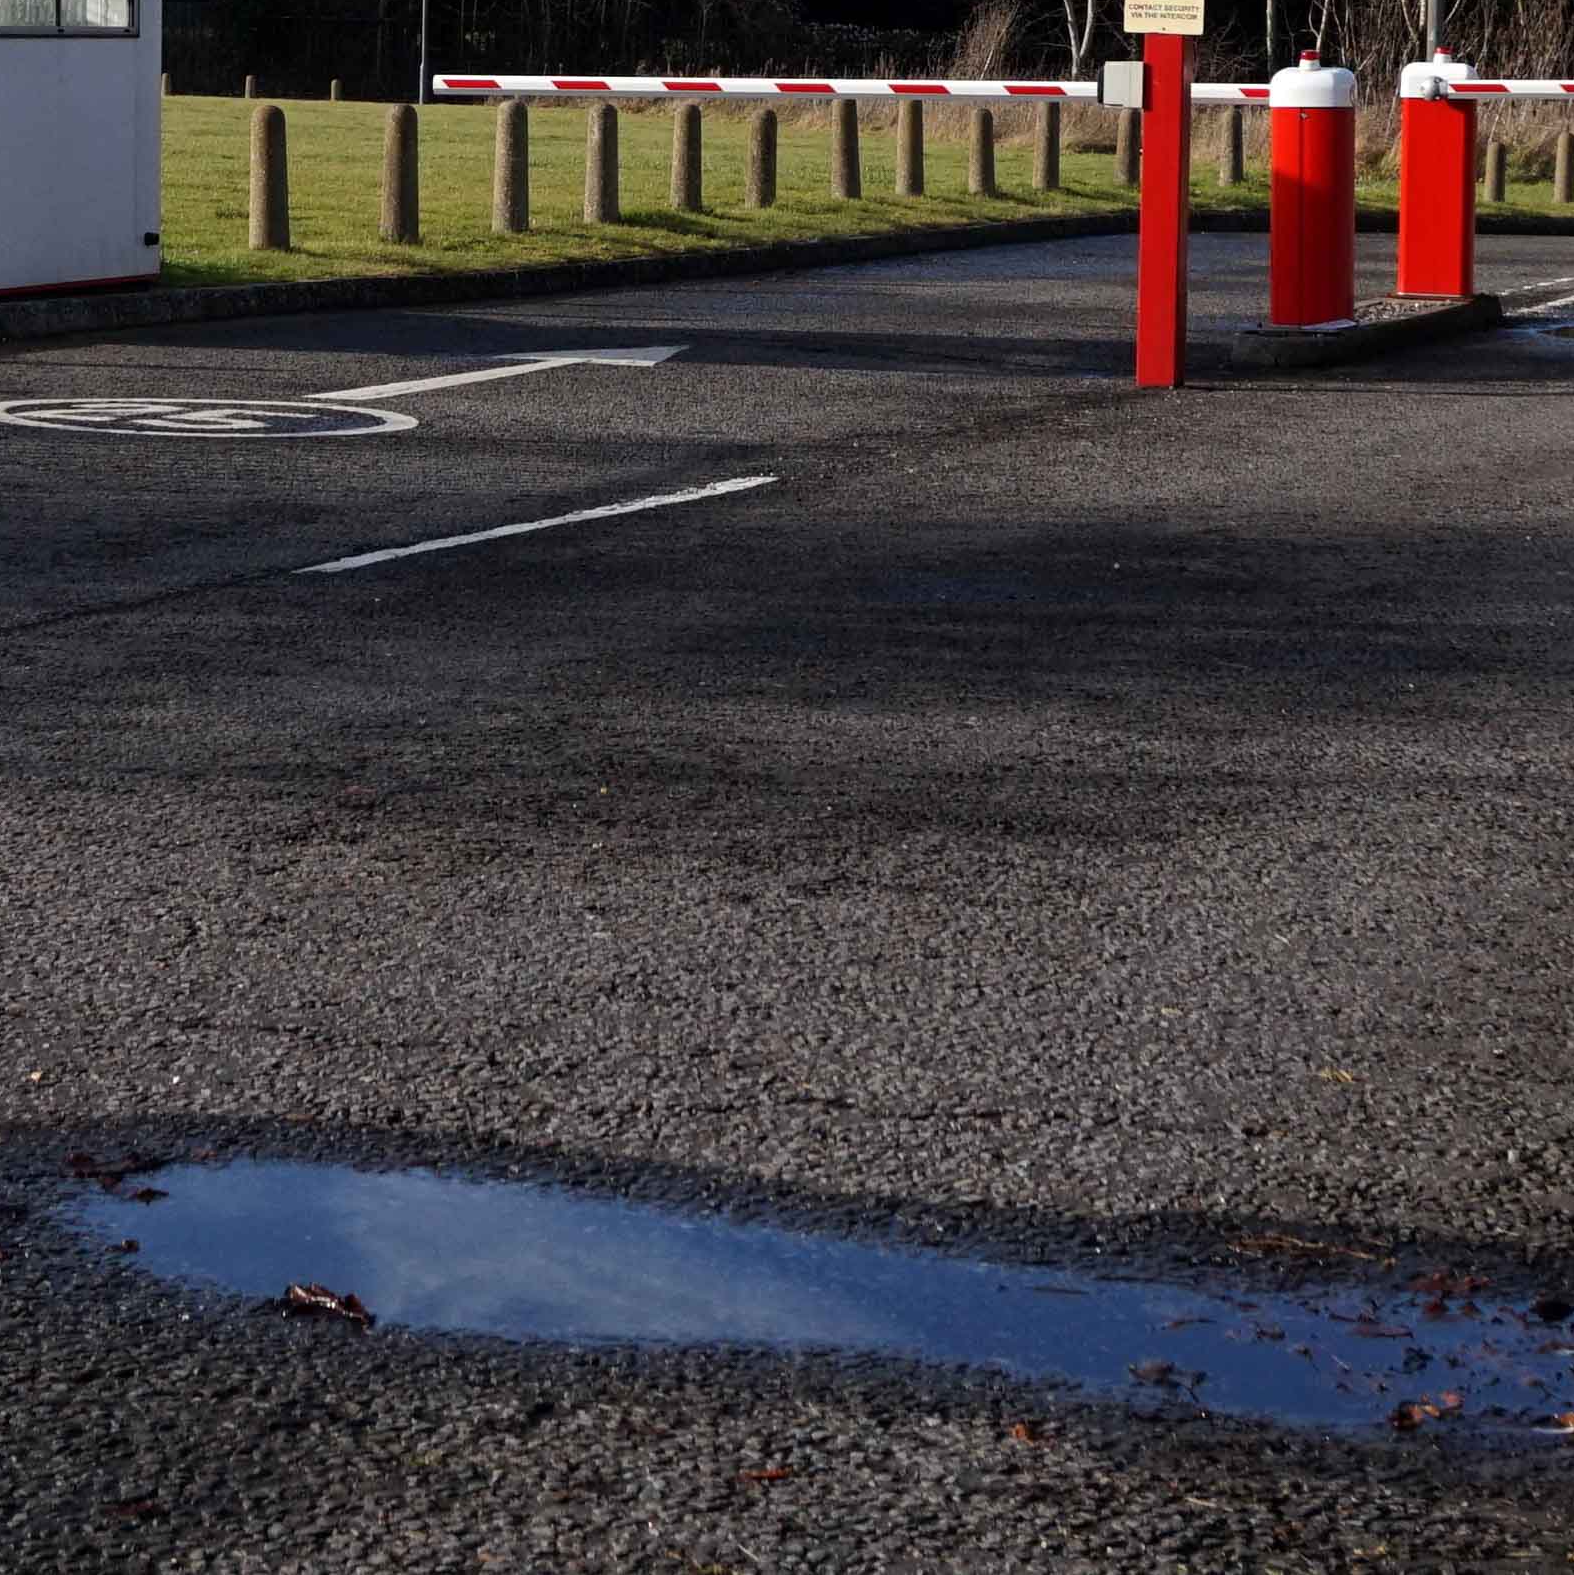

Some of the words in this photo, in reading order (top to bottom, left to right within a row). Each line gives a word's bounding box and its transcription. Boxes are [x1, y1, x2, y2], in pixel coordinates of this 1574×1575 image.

[1164, 4, 1200, 12] SECURITY
[1160, 12, 1198, 20] INTERCOM
[11, 403, 317, 429] 25
